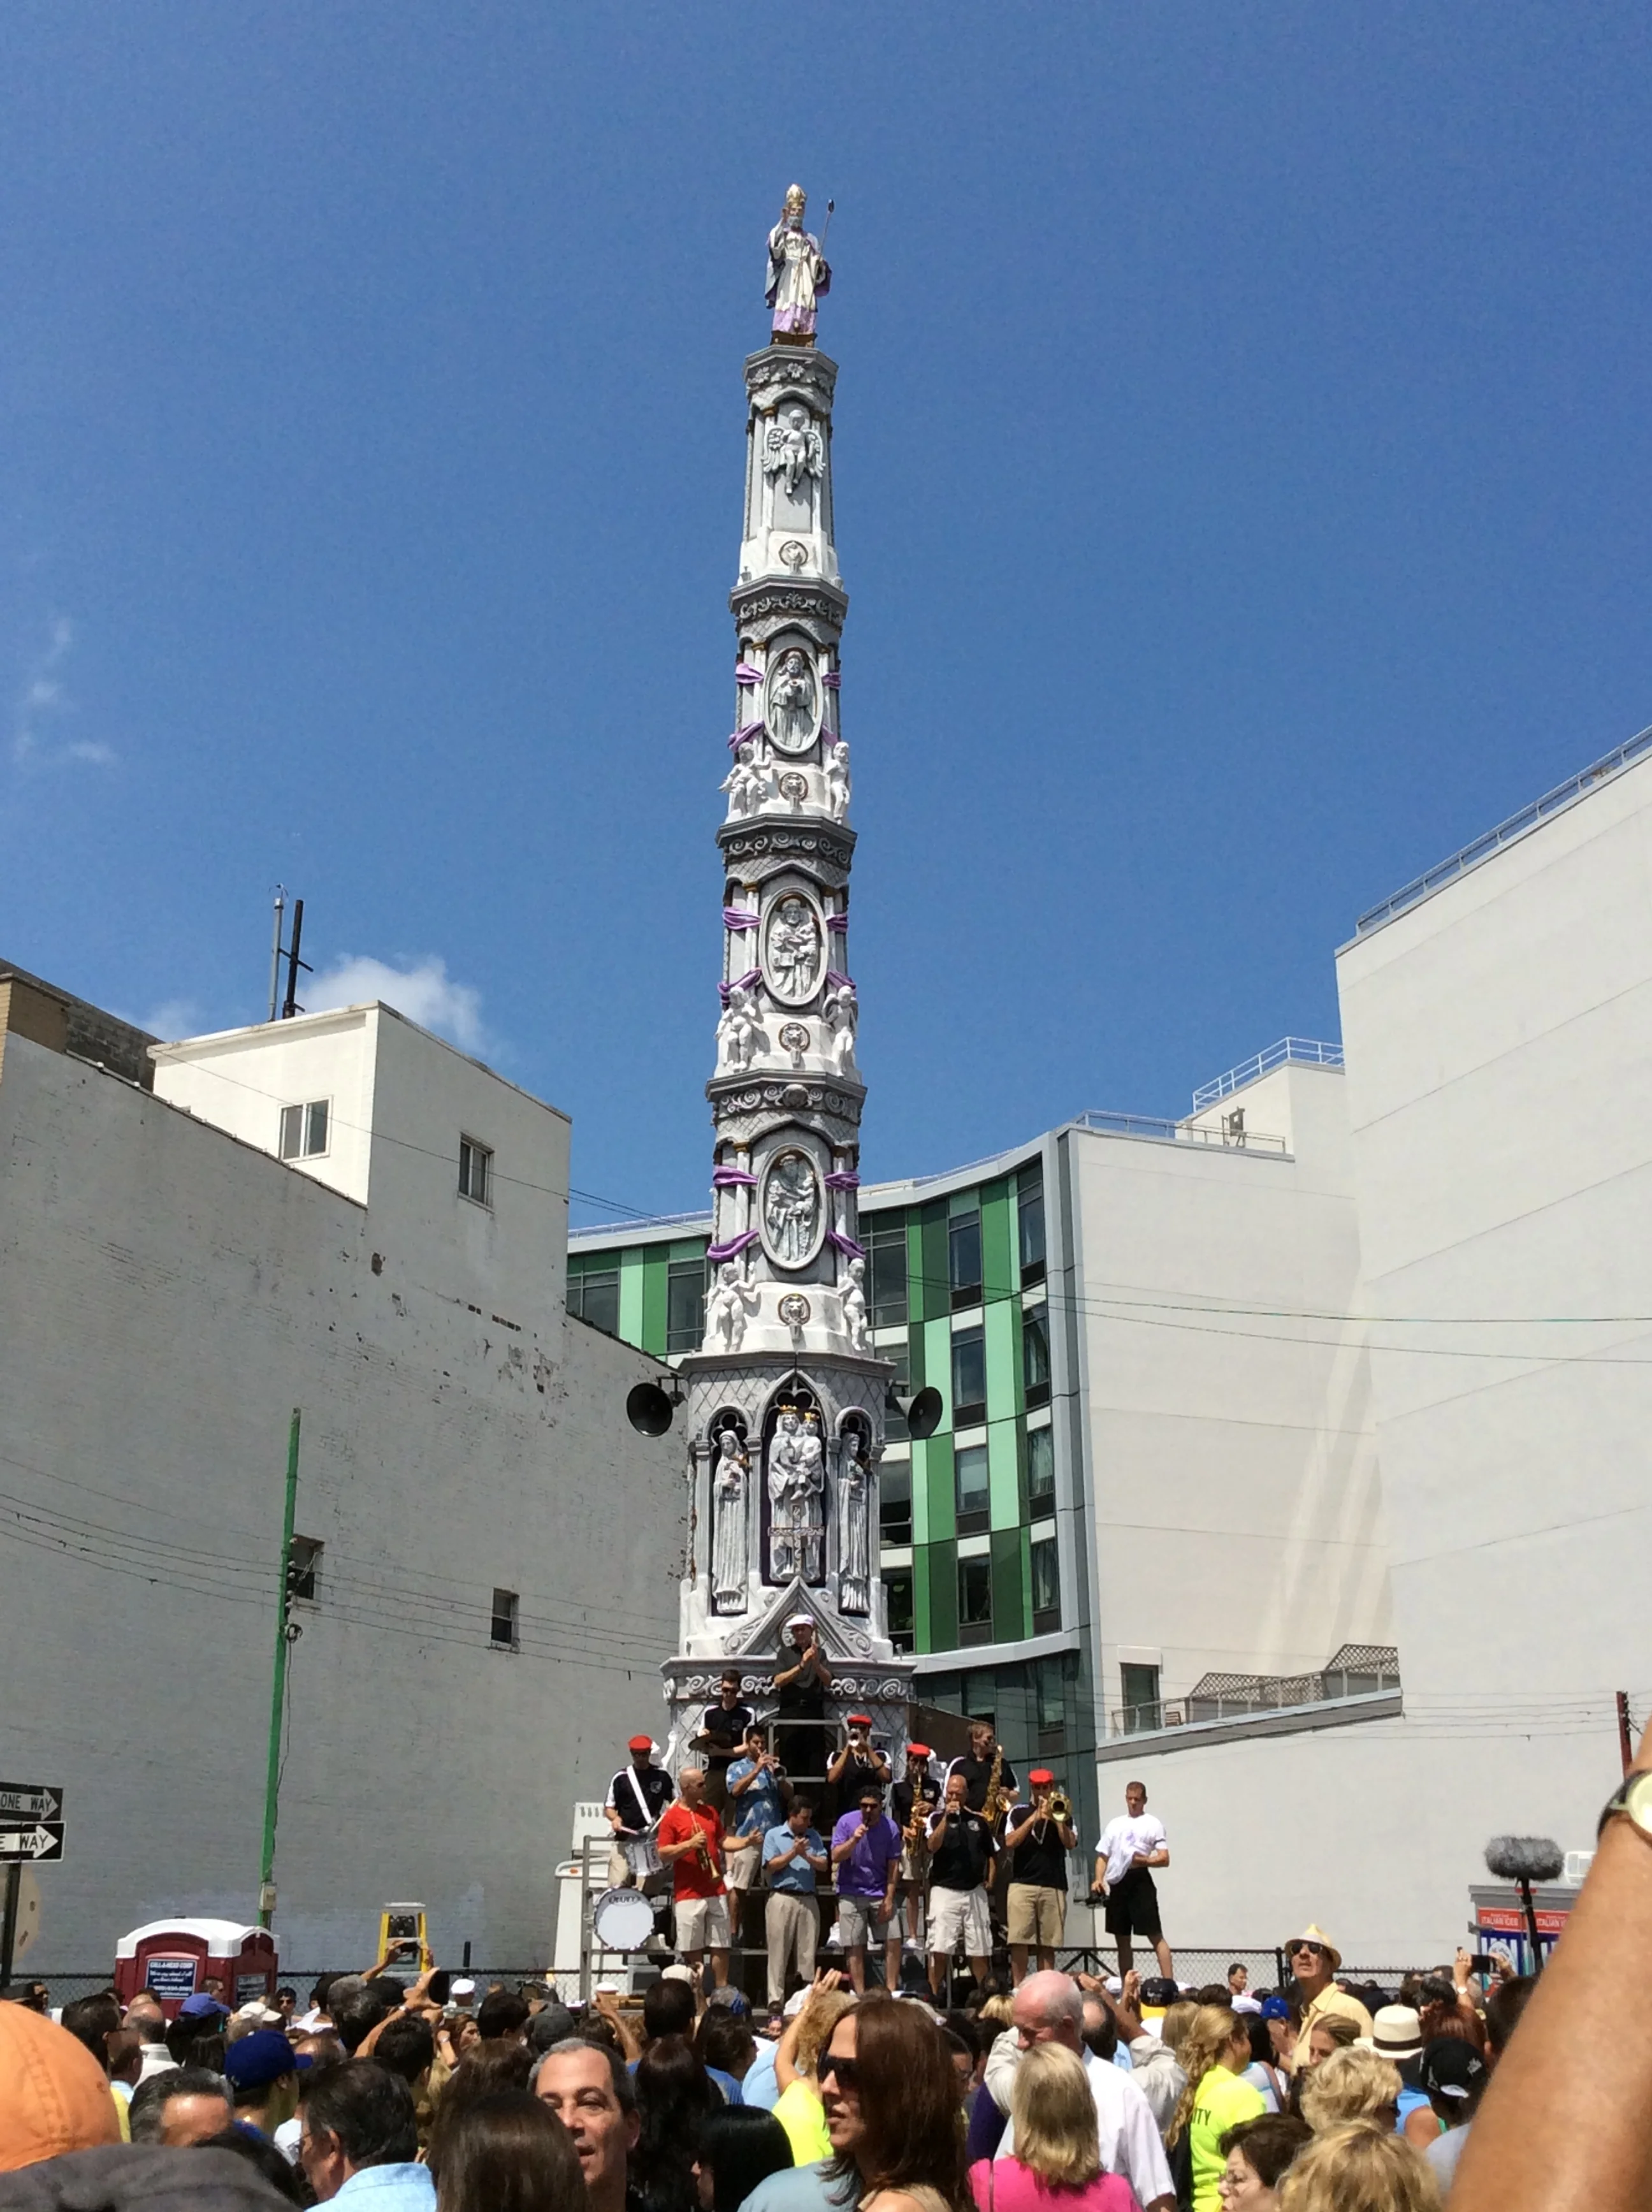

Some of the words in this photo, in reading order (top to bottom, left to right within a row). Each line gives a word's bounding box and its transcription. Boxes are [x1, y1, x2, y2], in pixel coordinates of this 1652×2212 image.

[1, 1793, 21, 1809] ONE
[31, 1796, 52, 1812] WAY
[20, 1835, 48, 1849] WAY
